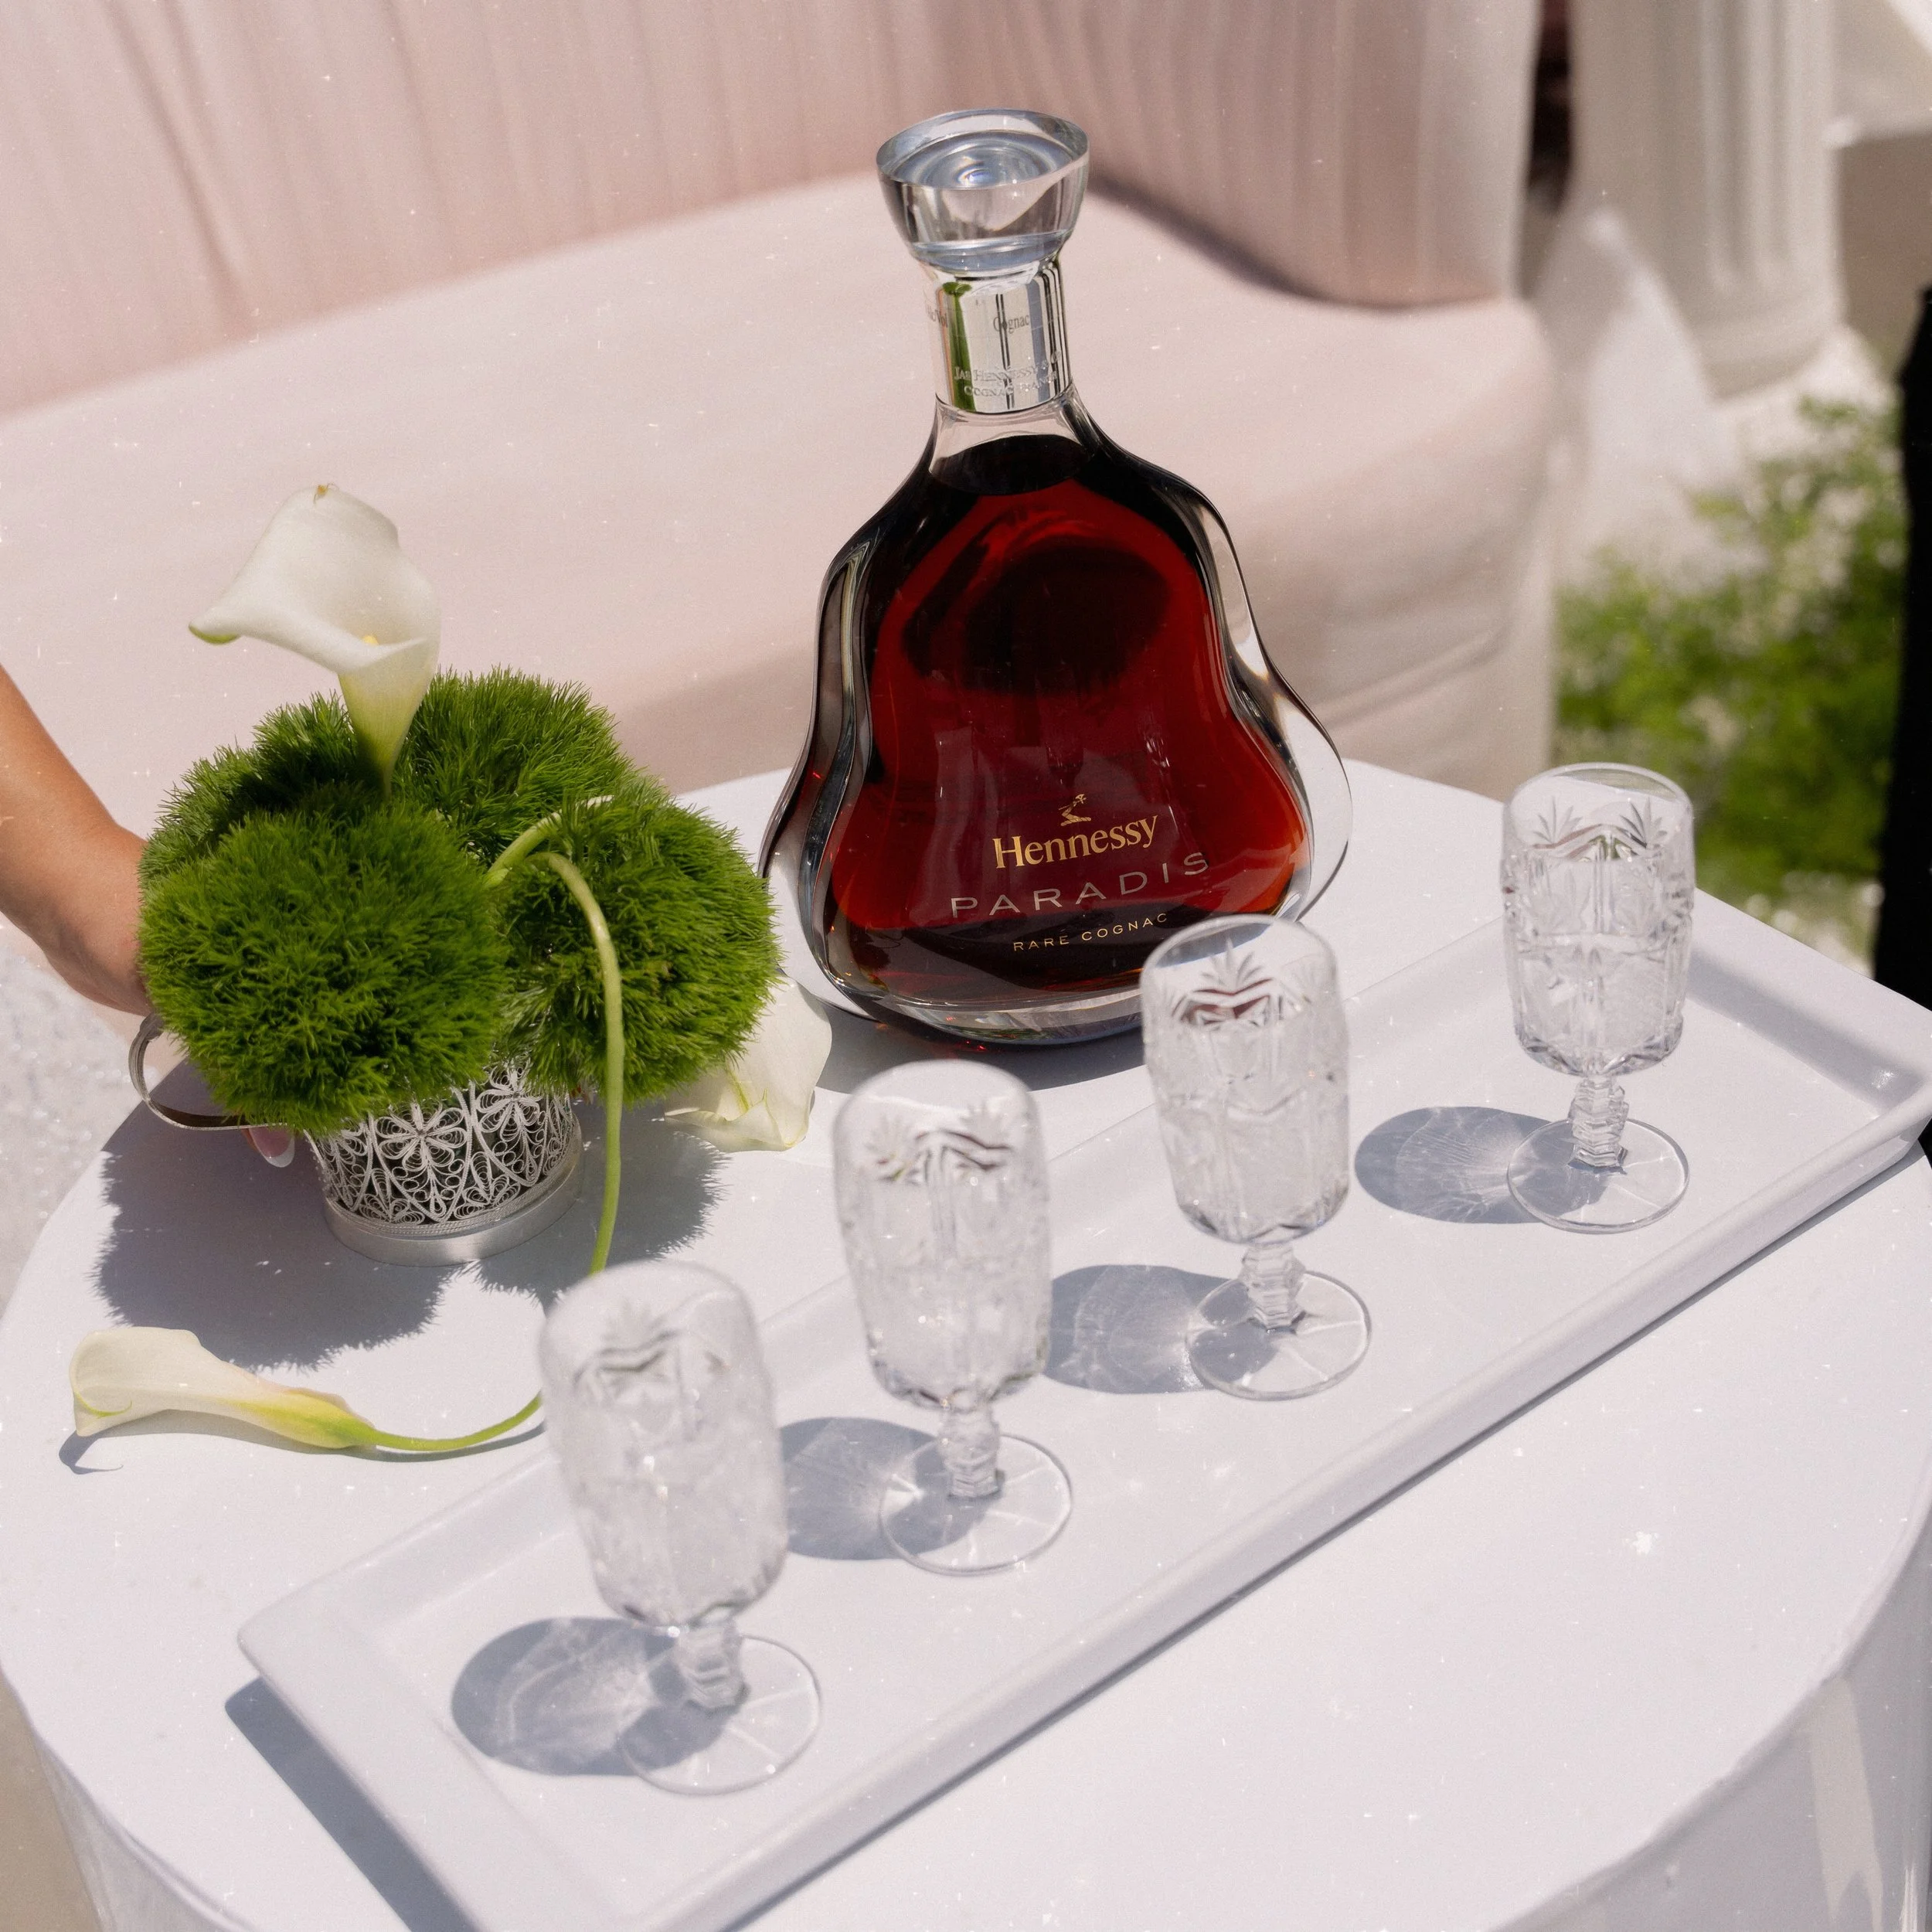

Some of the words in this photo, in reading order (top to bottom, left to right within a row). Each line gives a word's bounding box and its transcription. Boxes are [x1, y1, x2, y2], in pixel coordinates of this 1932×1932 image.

[993, 315, 1029, 334] Cognac
[992, 815, 1158, 869] Hennessy
[951, 852, 1209, 919] PARADIS
[1013, 935, 1070, 952] RARE
[1081, 913, 1168, 941] COGNAC
